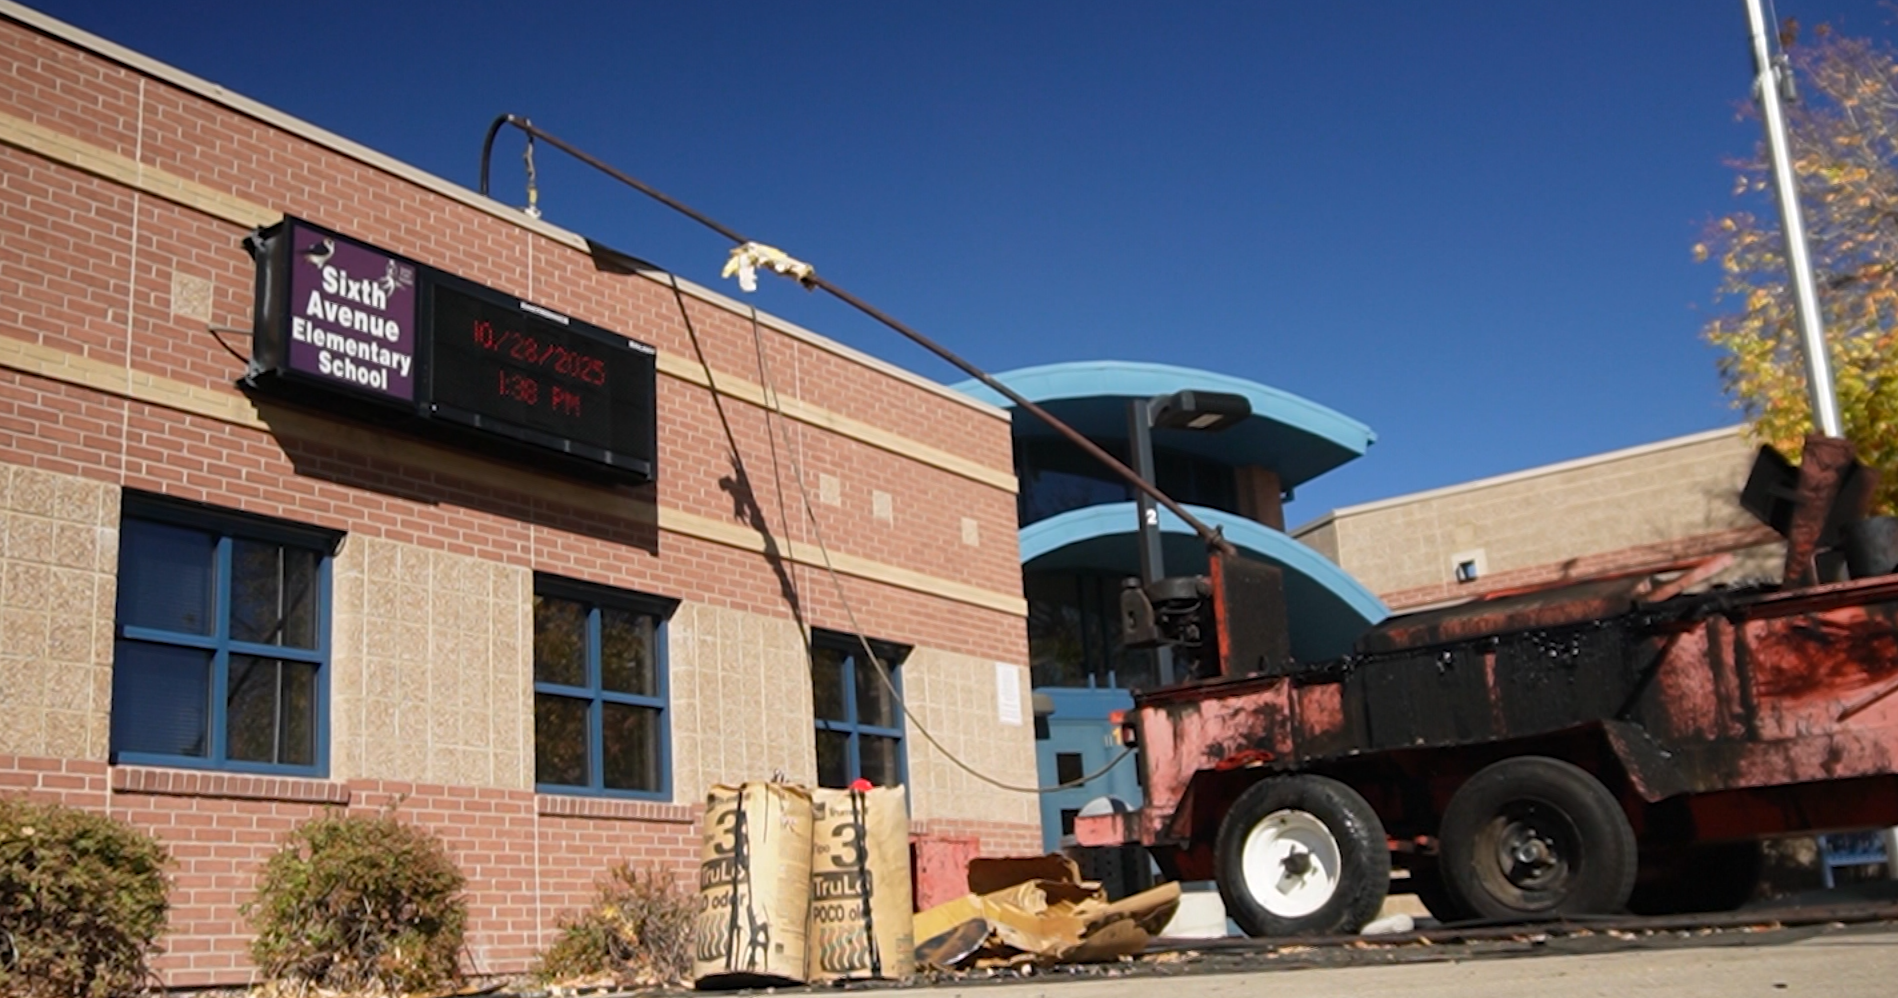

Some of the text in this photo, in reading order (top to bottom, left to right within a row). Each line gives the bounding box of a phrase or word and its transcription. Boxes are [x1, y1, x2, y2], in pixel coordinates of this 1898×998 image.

[321, 265, 387, 311] Sixth
[305, 289, 400, 342] Avenue
[291, 316, 411, 377] Elementary
[473, 320, 605, 386] 10/28/2025
[318, 349, 388, 391] School
[552, 385, 581, 418] PM
[1146, 508, 1158, 525] 2
[714, 809, 749, 856] 3
[831, 822, 869, 867] 3
